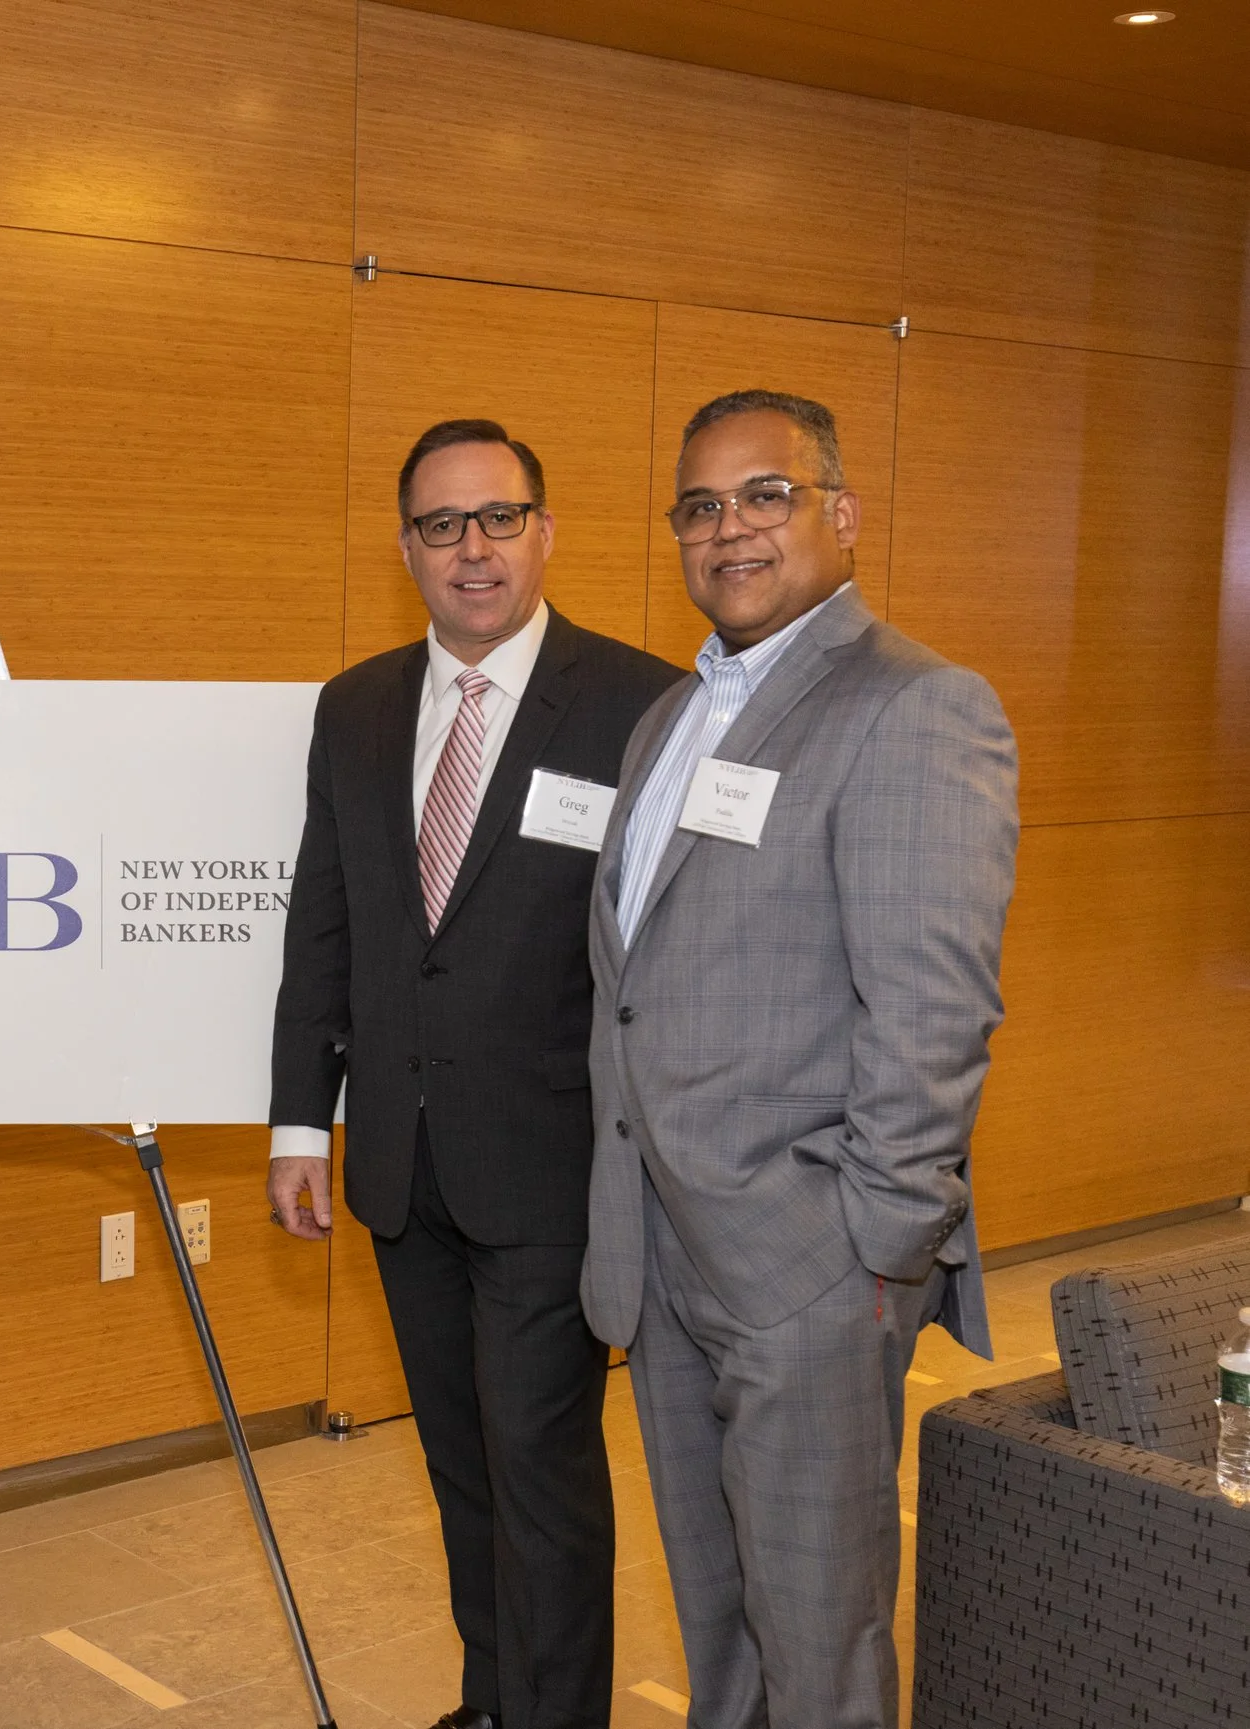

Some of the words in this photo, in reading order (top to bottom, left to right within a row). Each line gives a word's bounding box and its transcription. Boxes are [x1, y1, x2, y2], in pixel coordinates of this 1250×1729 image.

[715, 782, 750, 801] Victor
[559, 796, 589, 815] Greg
[120, 861, 184, 879] NEW
[190, 861, 270, 879] YORK
[277, 861, 297, 879] L
[121, 892, 158, 911] OF
[120, 923, 252, 942] BANKERS
